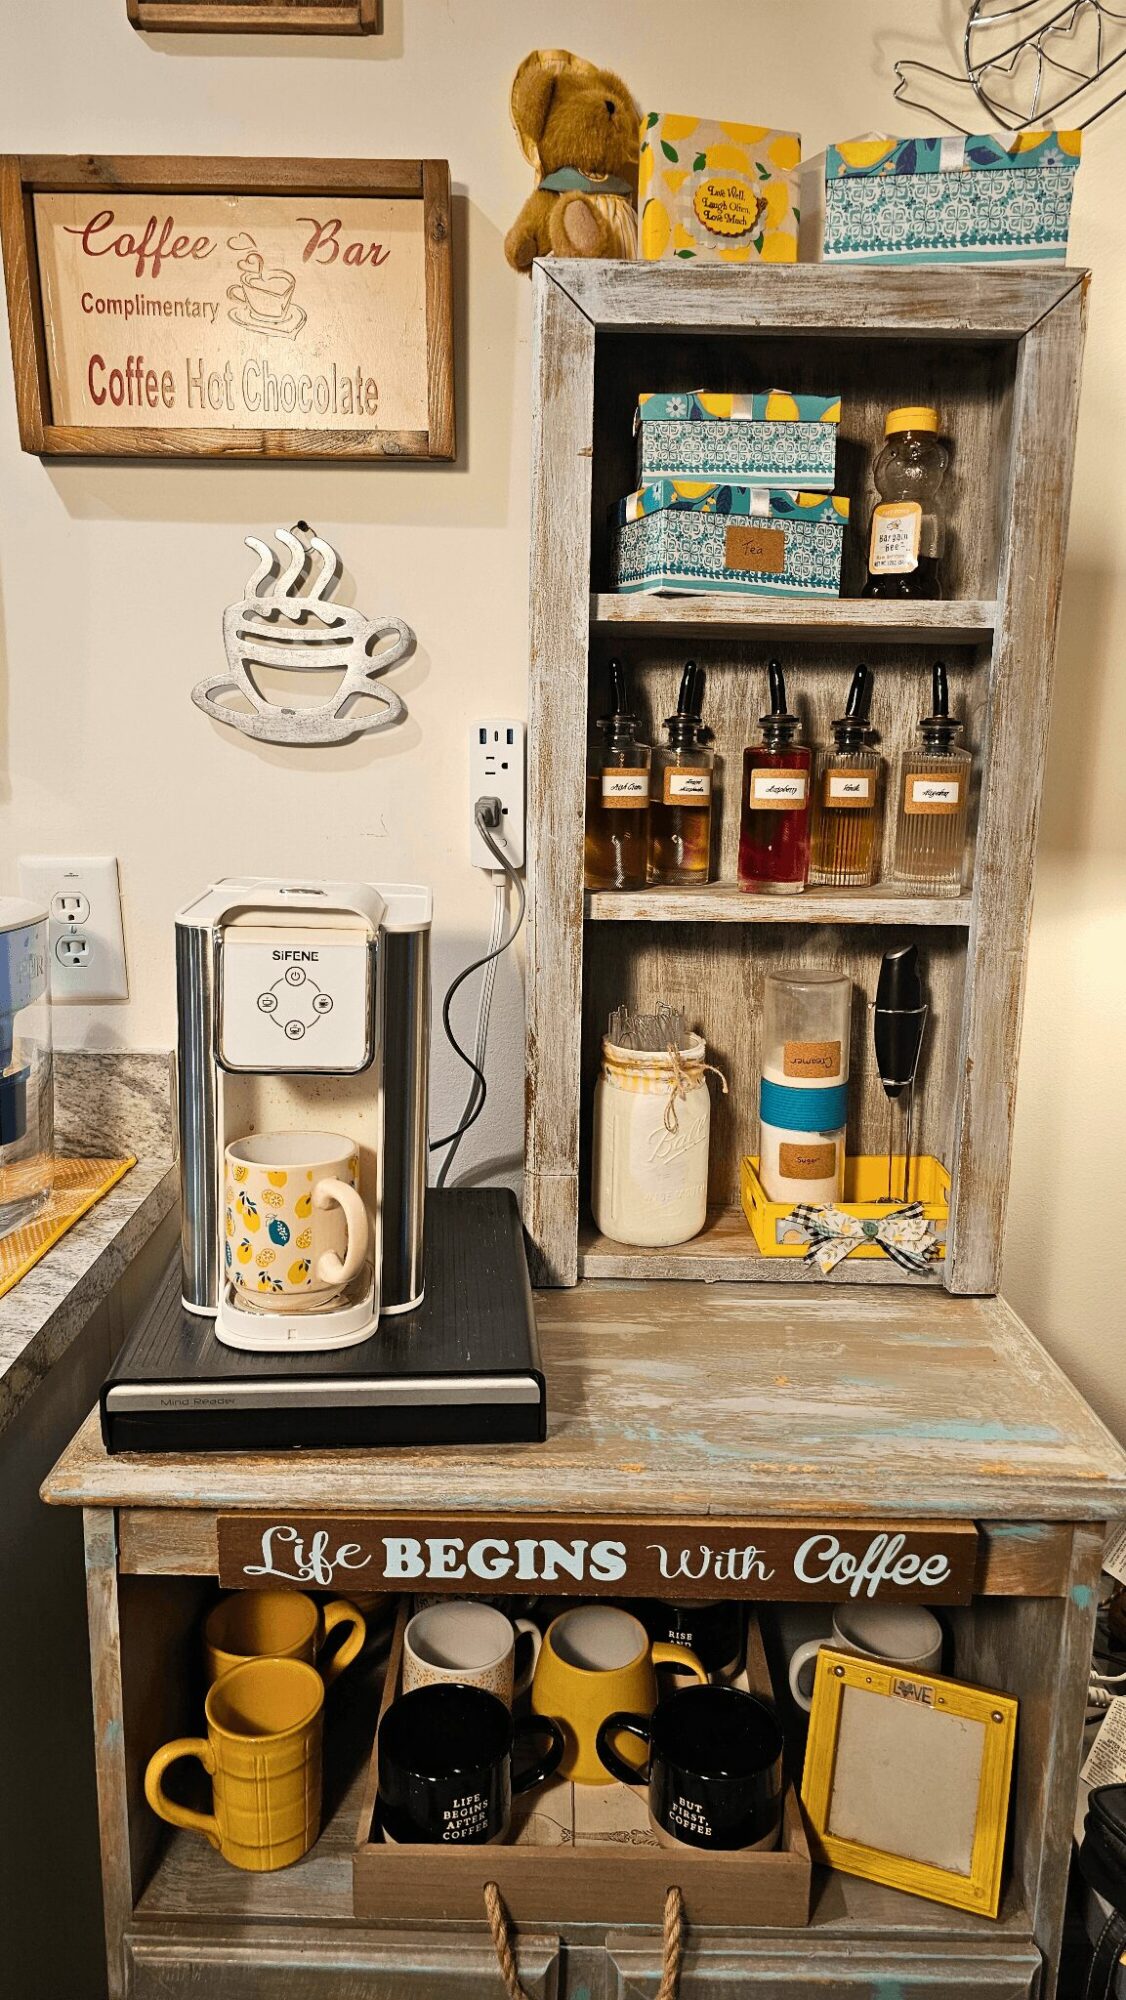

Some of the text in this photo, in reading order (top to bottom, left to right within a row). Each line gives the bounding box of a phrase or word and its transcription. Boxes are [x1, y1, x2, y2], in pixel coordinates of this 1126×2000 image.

[703, 209, 723, 222] Love
[63, 210, 391, 278] Coffee Bar
[81, 292, 219, 323] Complimentary
[88, 354, 379, 415] Coffee Hot Chocolate
[742, 540, 763, 555] Tea
[243, 1525, 951, 1598] Life BEGINS With Coffee
[668, 1630, 693, 1641] RISE
[443, 1799, 488, 1820] BEGINS
[453, 1793, 480, 1808] LIFE
[679, 1796, 703, 1813] BUT
[442, 1819, 488, 1840] COFFEE
[446, 1812, 485, 1829] AFTER
[669, 1811, 712, 1836] COFFEE
